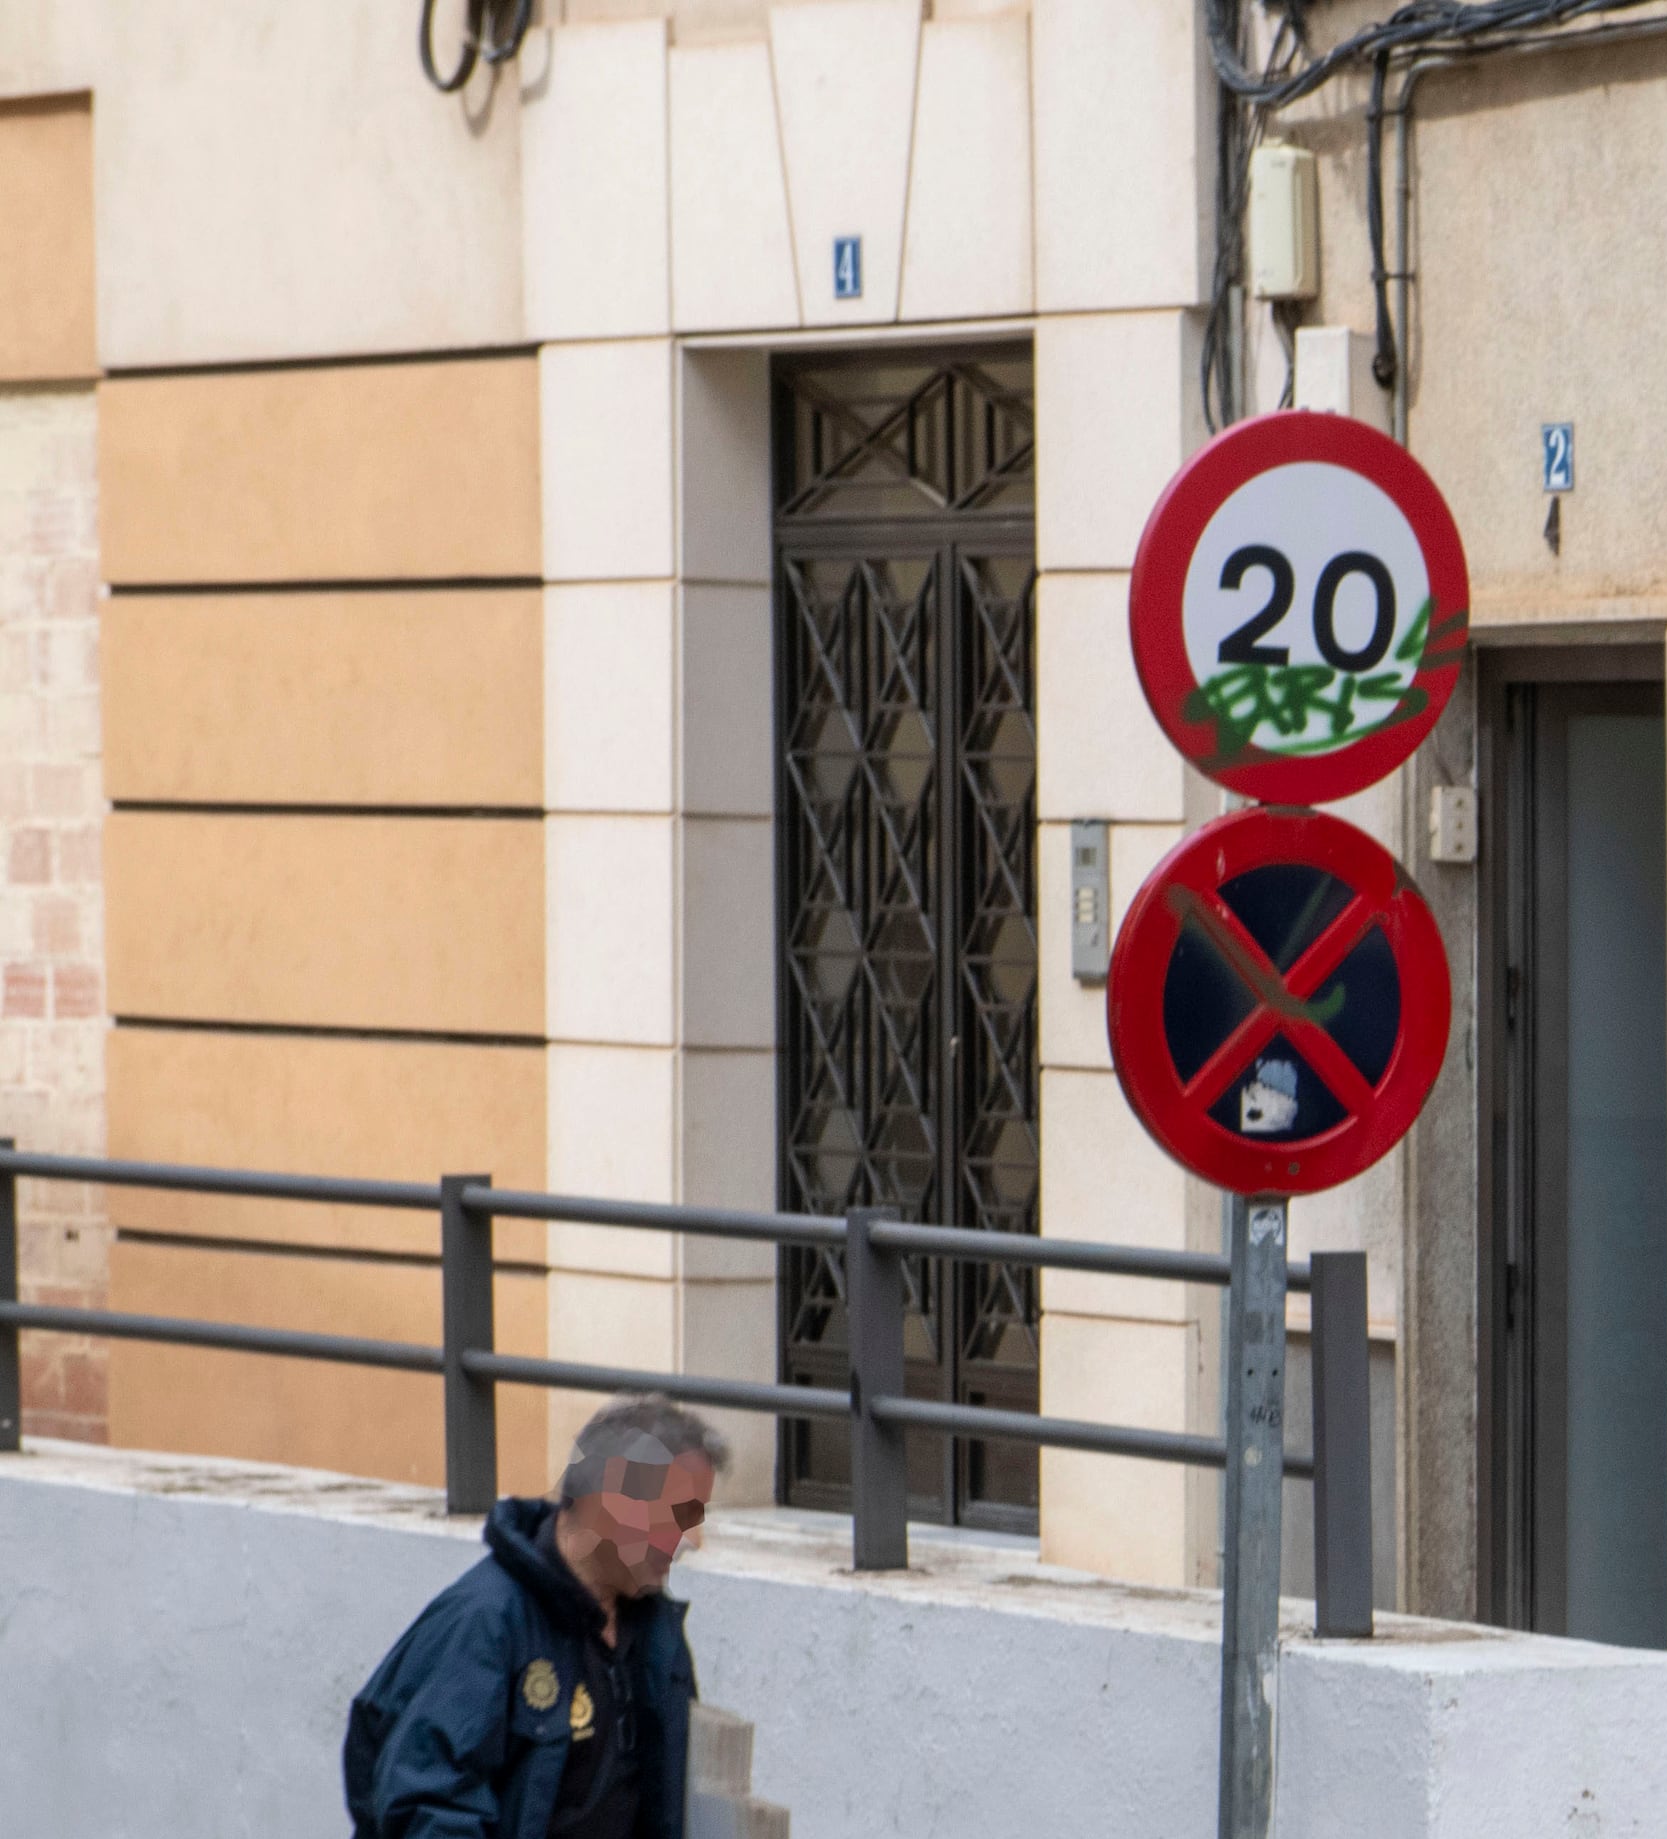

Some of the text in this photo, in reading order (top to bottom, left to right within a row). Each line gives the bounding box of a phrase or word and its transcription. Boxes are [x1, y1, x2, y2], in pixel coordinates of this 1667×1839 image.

[838, 243, 853, 293] 4
[1548, 427, 1566, 486] 2
[1218, 543, 1397, 673] 20
